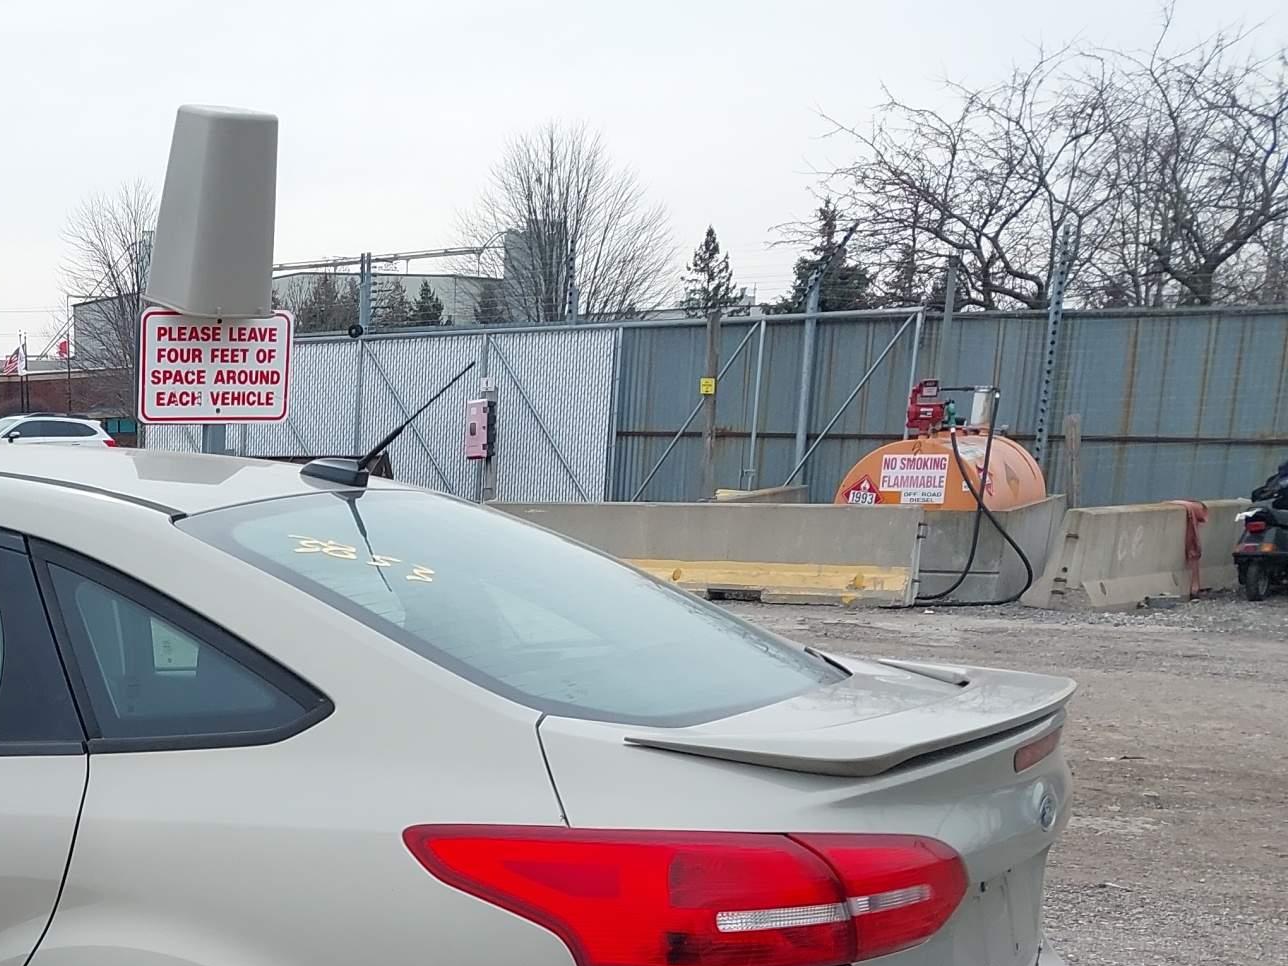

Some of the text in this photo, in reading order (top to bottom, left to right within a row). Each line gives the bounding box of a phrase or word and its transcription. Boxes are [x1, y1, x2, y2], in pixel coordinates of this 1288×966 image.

[157, 326, 277, 342] PLEASE LEAVE
[157, 348, 276, 363] FOUR FEET OF
[151, 370, 280, 384] SPACE AROUND
[156, 391, 274, 406] EACH VEHICLE
[883, 457, 947, 470] NO SMOKING
[881, 475, 944, 488] FLAMMABLE
[851, 491, 874, 504] 1993
